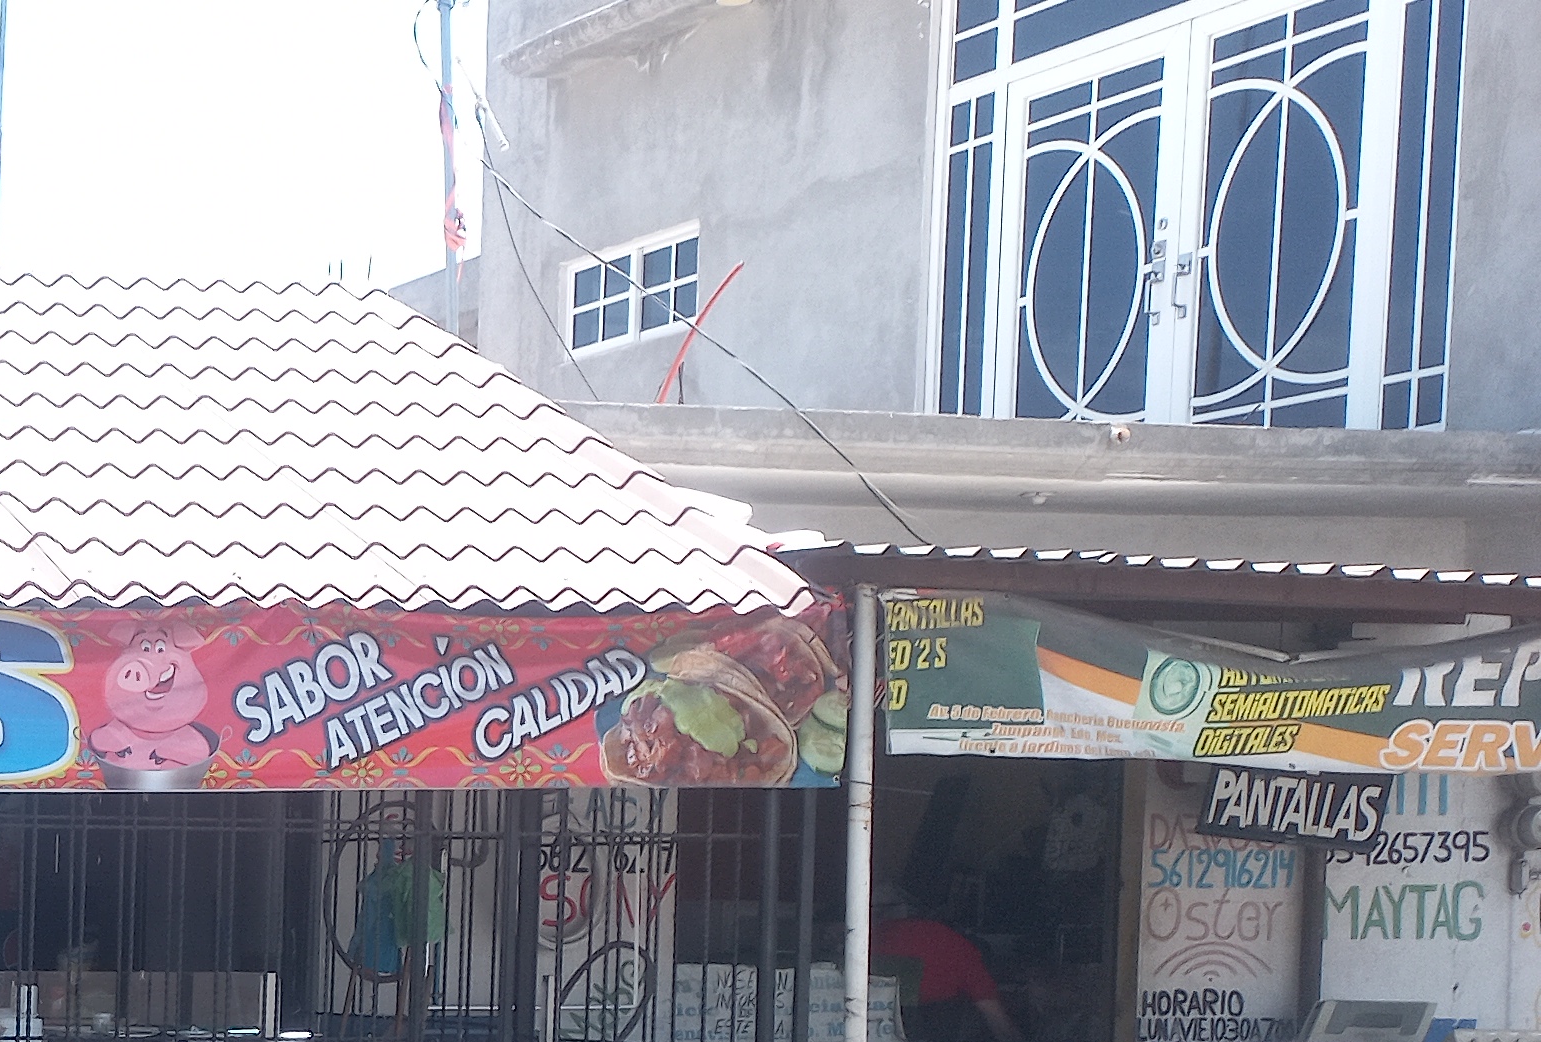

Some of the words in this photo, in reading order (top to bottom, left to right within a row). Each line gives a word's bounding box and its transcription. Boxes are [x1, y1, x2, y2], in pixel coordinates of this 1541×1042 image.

[235, 632, 393, 746] SABOR
[325, 636, 515, 769] ATENCIÓN
[475, 646, 649, 760] CALIDAD
[1378, 718, 1541, 773] SERV
[1206, 768, 1382, 842] PANTALLAS
[1323, 880, 1486, 942] MAYTAG
[1141, 987, 1245, 1017] HORARIO
